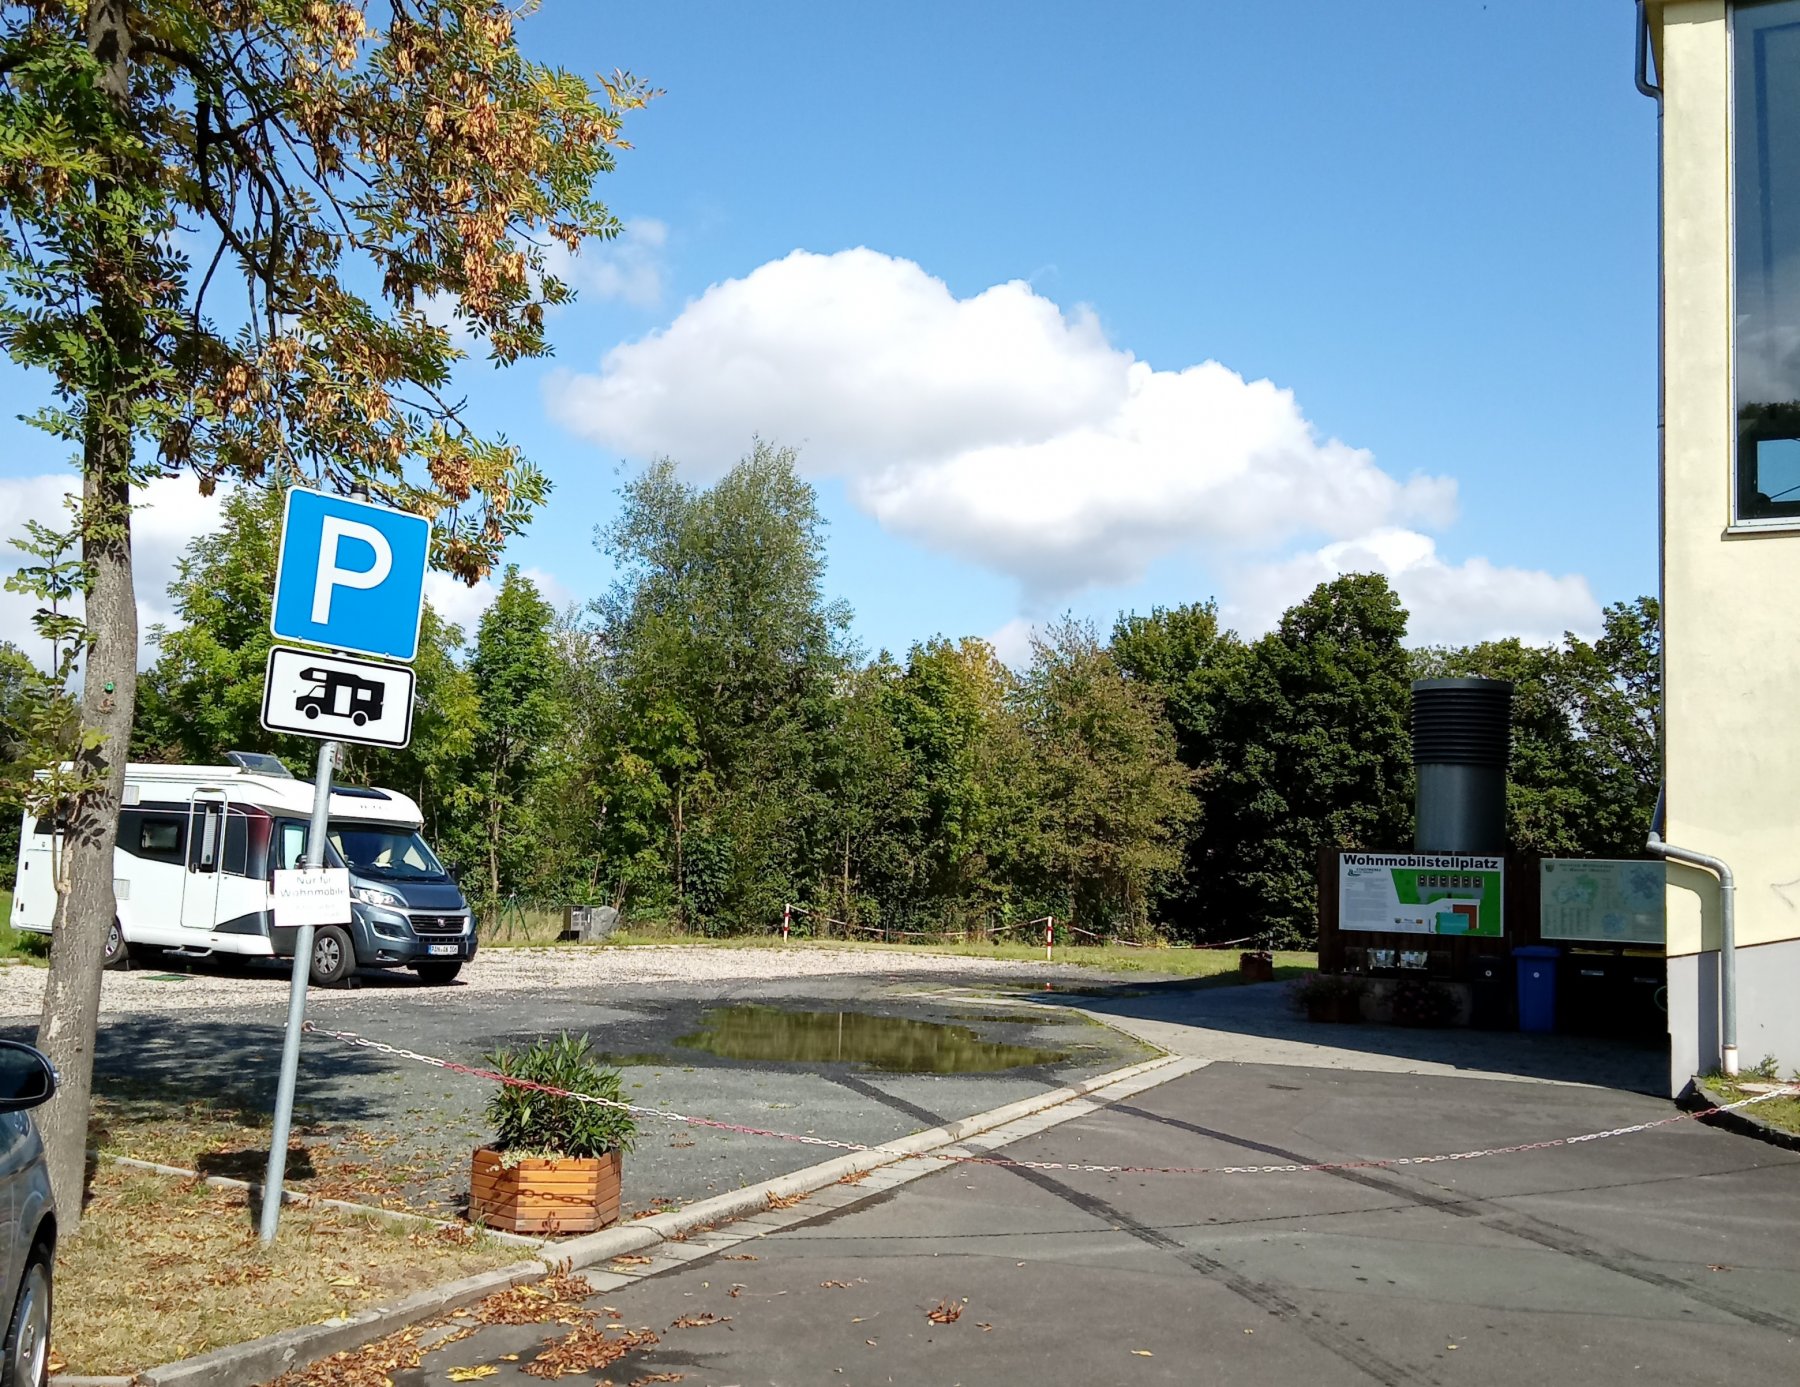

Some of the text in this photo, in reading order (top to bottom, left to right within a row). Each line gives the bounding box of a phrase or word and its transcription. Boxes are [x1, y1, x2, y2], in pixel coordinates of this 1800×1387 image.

[311, 515, 393, 625] P
[1343, 854, 1499, 871] Wohnmobilstellplatz
[296, 876, 316, 885] Nur
